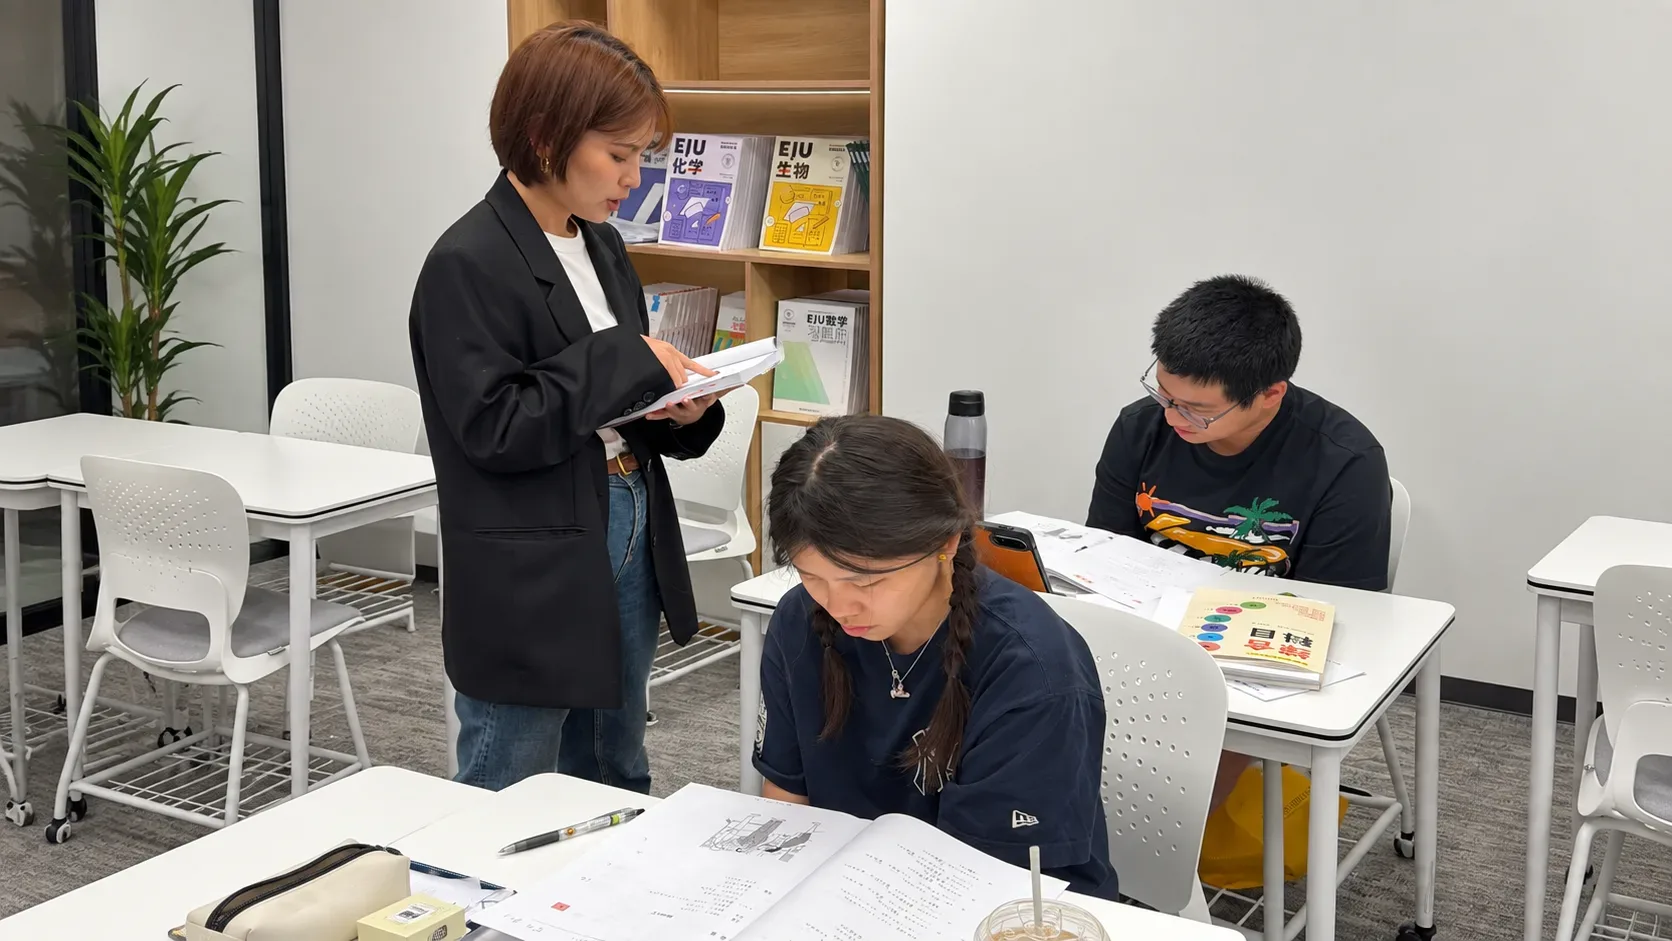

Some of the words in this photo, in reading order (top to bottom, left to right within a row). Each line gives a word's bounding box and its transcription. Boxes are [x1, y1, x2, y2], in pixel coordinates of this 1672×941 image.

[674, 137, 707, 157] EJU
[778, 141, 814, 160] EJU
[672, 157, 704, 175] 化学
[775, 160, 810, 179] 生物
